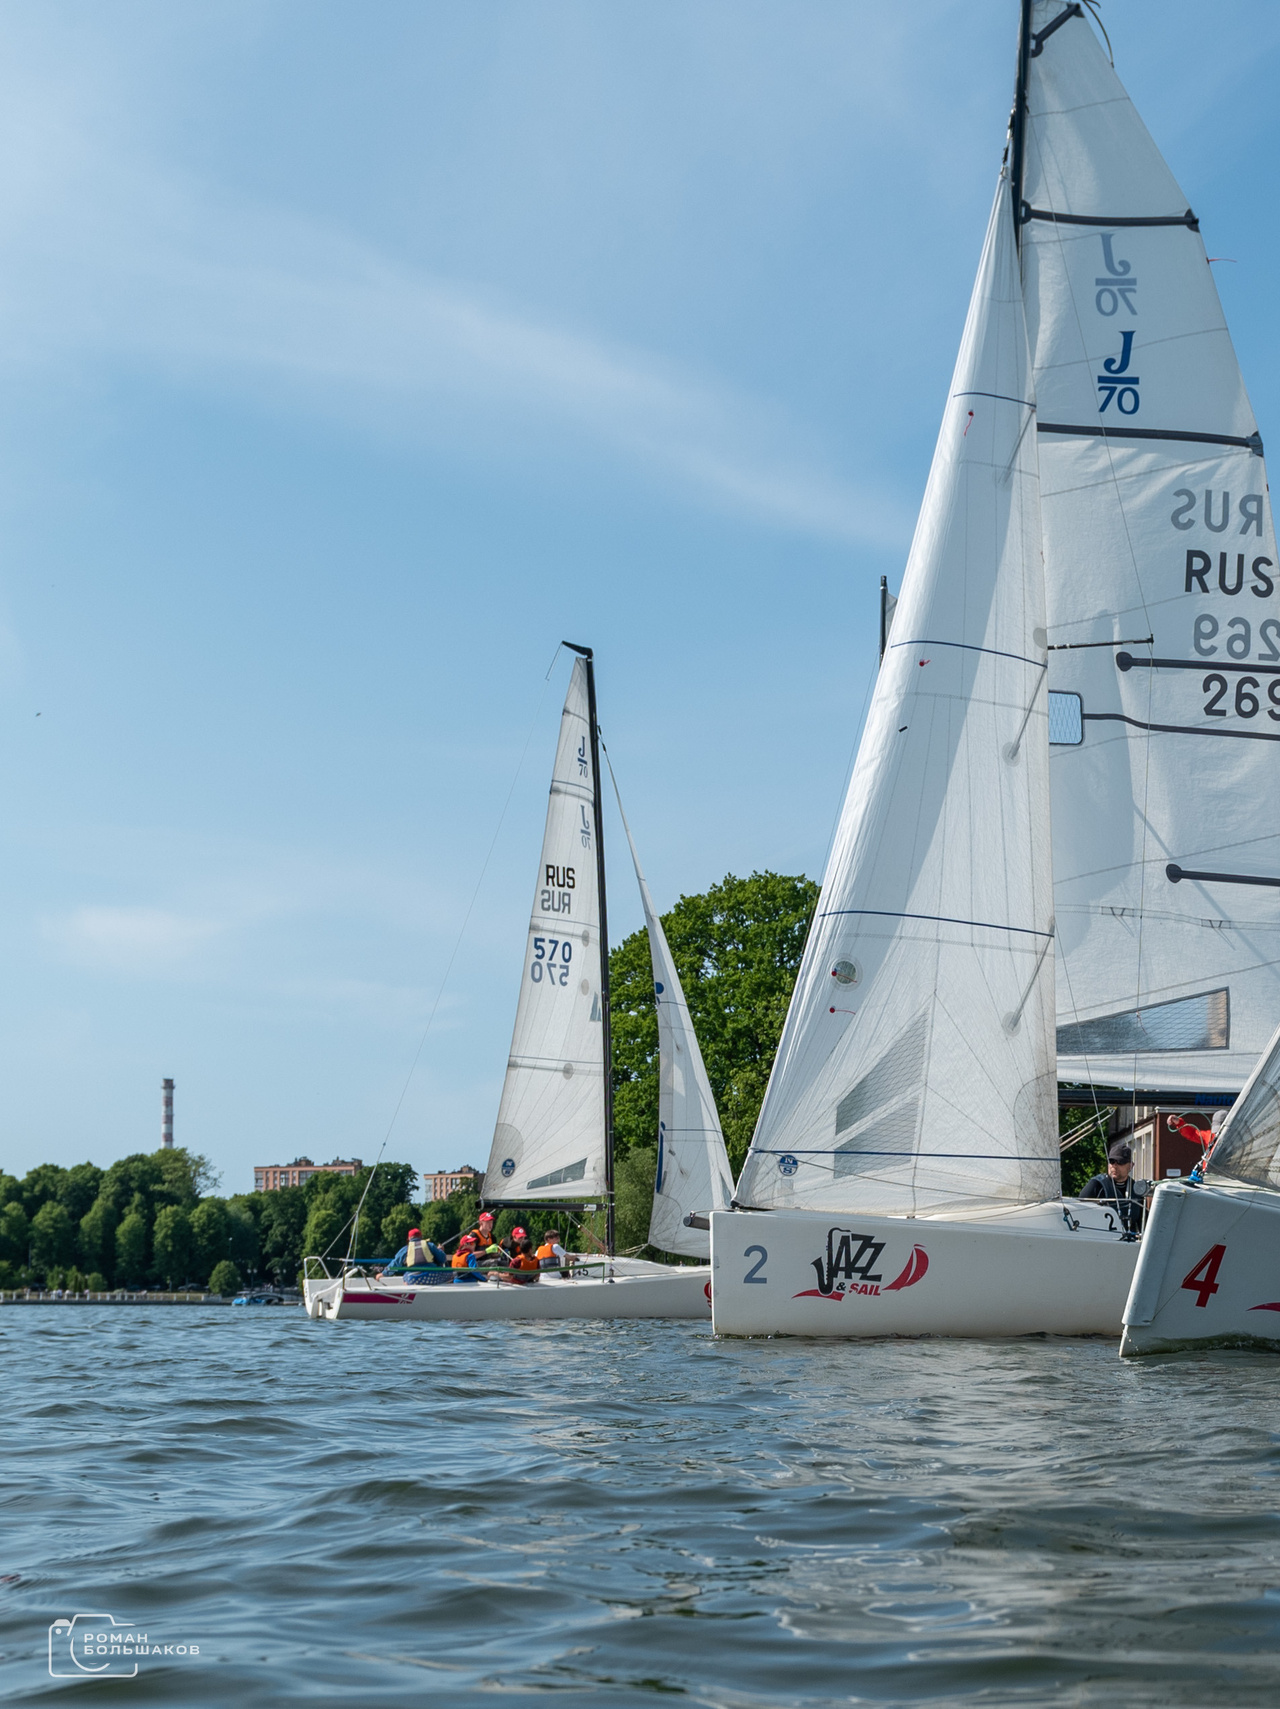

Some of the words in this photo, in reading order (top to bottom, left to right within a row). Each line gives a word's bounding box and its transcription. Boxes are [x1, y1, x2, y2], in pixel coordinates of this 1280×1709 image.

[1097, 385, 1140, 415] 70
[1184, 549, 1274, 598] RUS
[545, 864, 576, 889] RUS
[533, 937, 573, 964] 570
[1104, 1213, 1117, 1231] 2
[743, 1244, 768, 1284] 2
[810, 1227, 887, 1296] JAZZ
[1181, 1243, 1227, 1308] 4
[836, 1282, 846, 1292] &
[849, 1283, 881, 1297] SAIL
